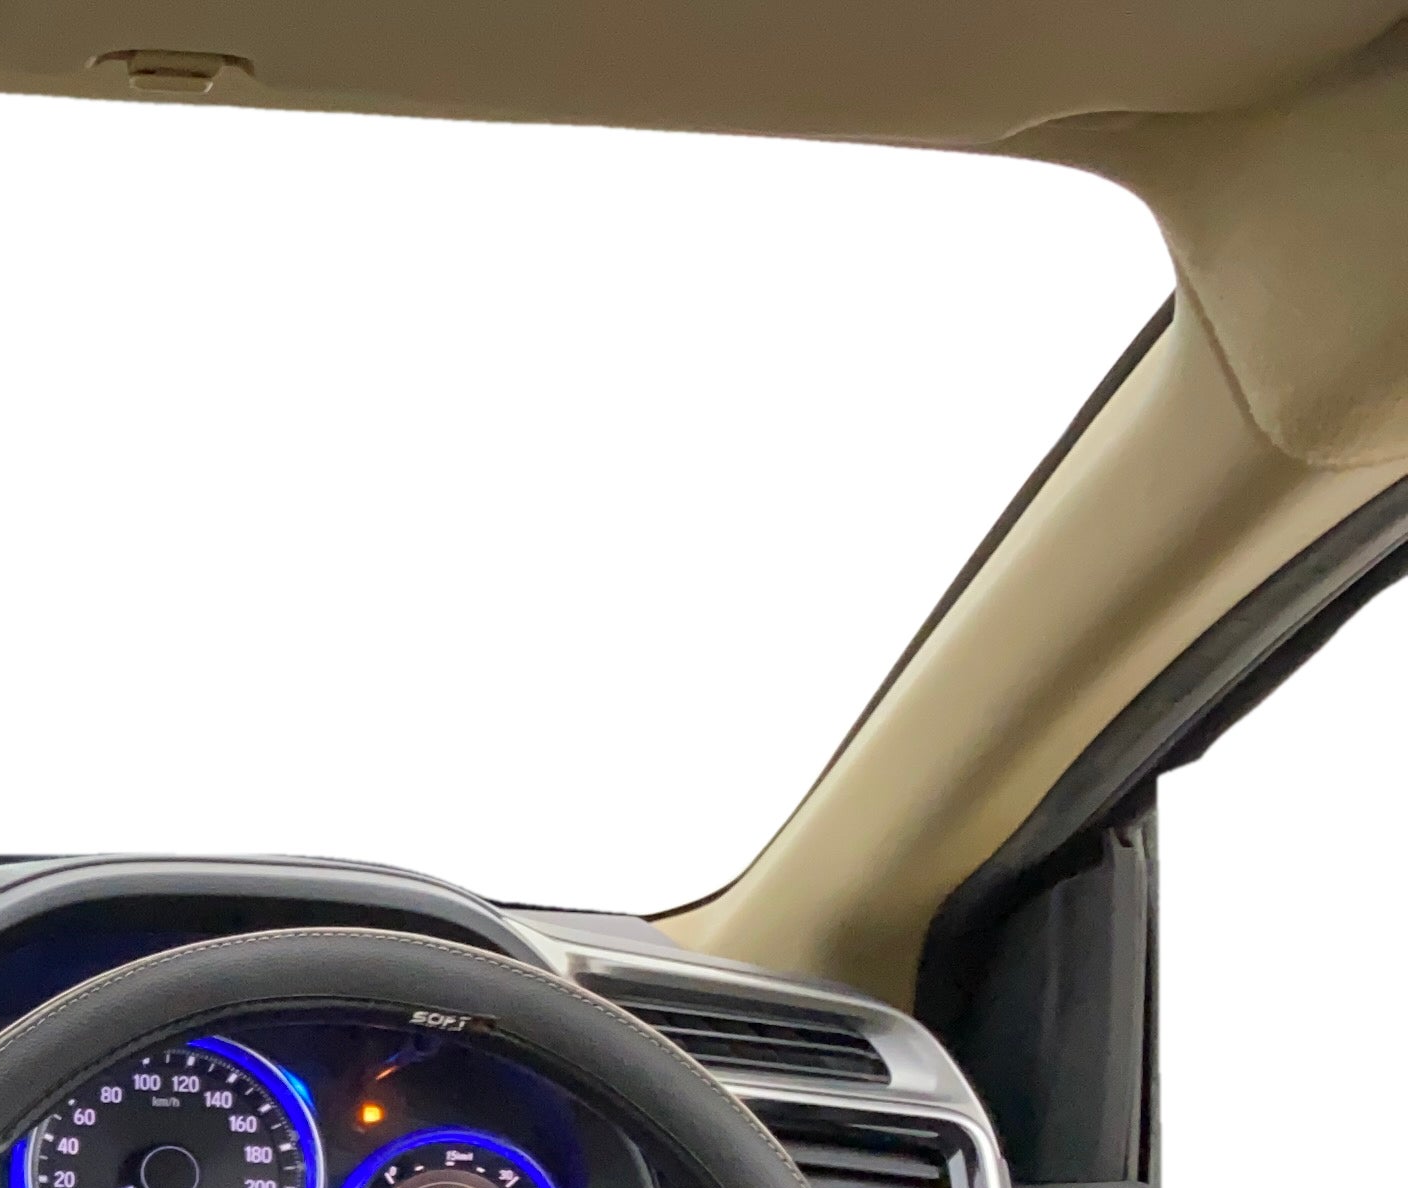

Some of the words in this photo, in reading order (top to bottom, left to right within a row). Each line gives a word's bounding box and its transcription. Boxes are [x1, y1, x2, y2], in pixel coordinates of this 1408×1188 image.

[133, 1074, 161, 1091] 100
[172, 1076, 200, 1093] 120
[100, 1087, 122, 1104] 80
[152, 1096, 180, 1108] km/h
[204, 1091, 232, 1109] 140
[73, 1108, 96, 1126] 60
[229, 1115, 257, 1133] 160
[57, 1138, 79, 1155] 40
[244, 1146, 273, 1164] 180
[54, 1171, 75, 1188] 20
